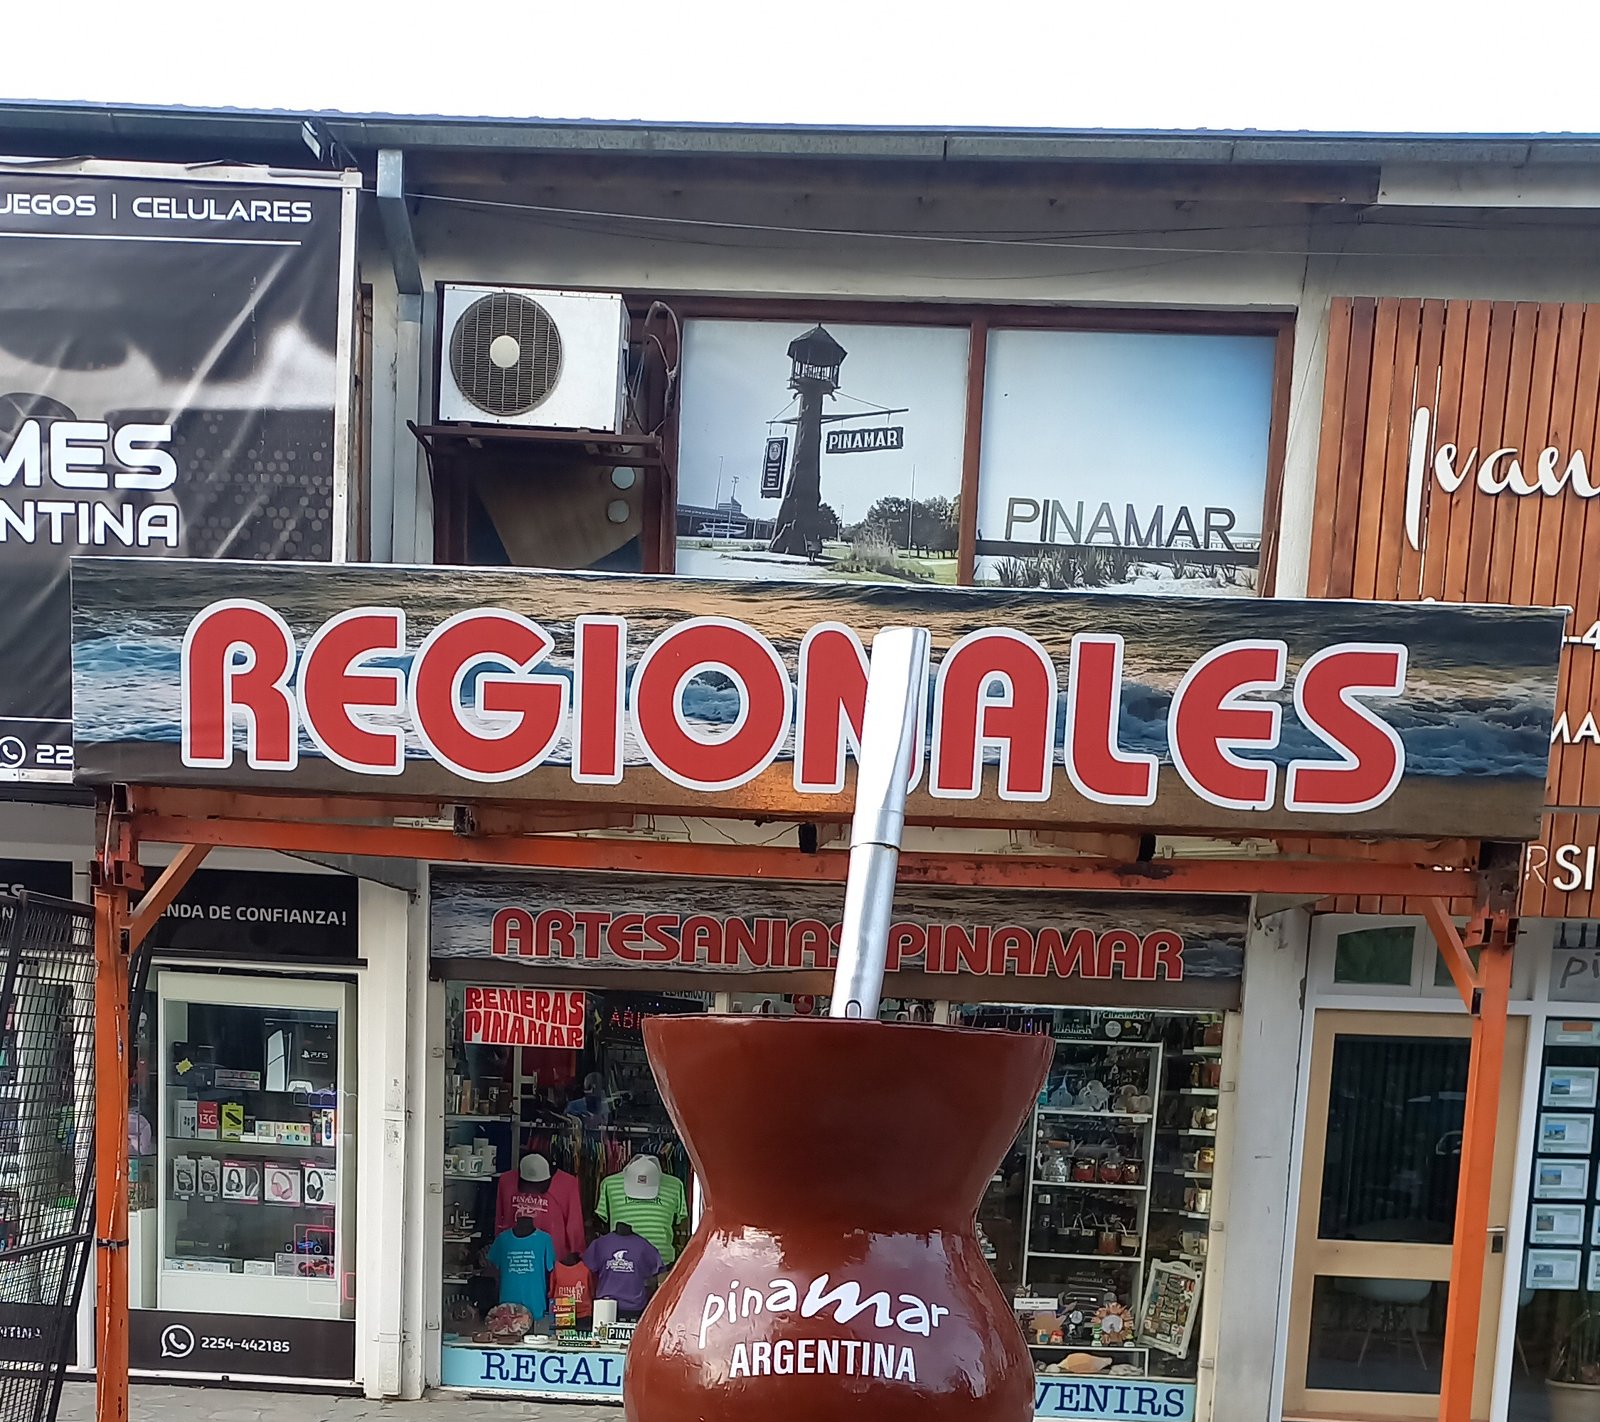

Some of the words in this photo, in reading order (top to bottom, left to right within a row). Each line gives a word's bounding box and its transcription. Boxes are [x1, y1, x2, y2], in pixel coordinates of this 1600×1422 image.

[132, 197, 312, 222] CELULARES
[828, 430, 899, 450] PINAMAR
[1004, 497, 1237, 550] PINAMAR
[181, 598, 1408, 813] REGIONALES
[36, 744, 74, 764] 22
[160, 903, 204, 919] NDA
[209, 905, 232, 920] DE
[236, 907, 347, 926] CONFIANZA!
[884, 922, 1184, 981] PINAMAR
[465, 987, 584, 1027] REMERAS
[465, 1010, 583, 1048] PINAMAR
[201, 1337, 290, 1353] 2254-442185
[608, 1328, 635, 1339] PINA
[480, 1352, 621, 1387] REGAL
[729, 1338, 917, 1382] ARGENTINA
